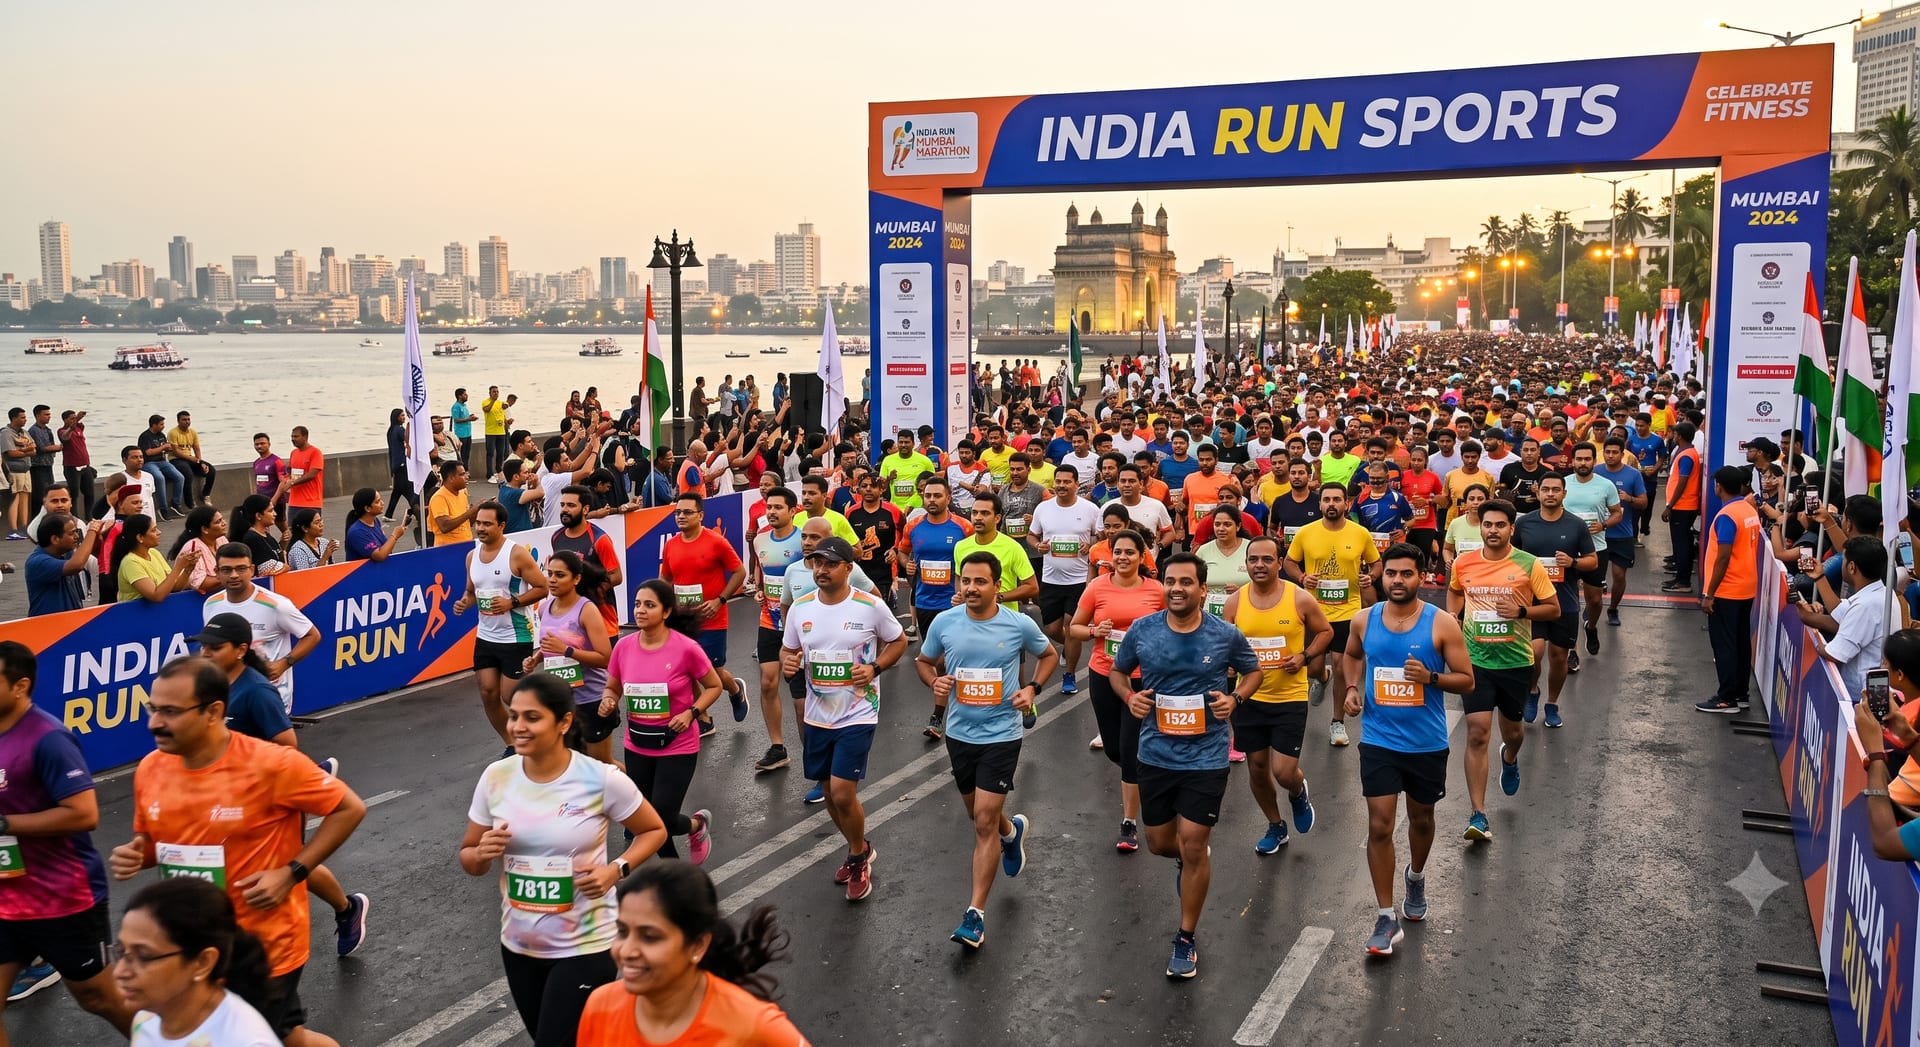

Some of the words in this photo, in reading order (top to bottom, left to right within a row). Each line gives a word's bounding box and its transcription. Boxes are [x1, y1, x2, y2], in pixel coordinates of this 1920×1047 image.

[1705, 80, 1813, 100] CELEBRATE
[1704, 98, 1810, 122] FITNESS
[1037, 110, 1196, 162] INDIA
[1213, 101, 1345, 155] RUN
[1359, 83, 1620, 149] SPORTS
[916, 128, 938, 137] INDIA
[939, 127, 955, 136] RUN
[916, 136, 955, 147] MUMBAI
[916, 146, 970, 157] MARATHON
[1731, 190, 1820, 208] MUMBAI
[1748, 210, 1799, 226] 2024
[875, 220, 936, 235] MUMBAI
[944, 221, 971, 236] MUMBAI
[888, 236, 923, 249] 2024
[949, 236, 966, 250] 2024
[925, 570, 946, 579] 9823
[335, 583, 428, 633] INDIA
[335, 623, 407, 671] RUN
[62, 632, 191, 694] INDIA
[816, 665, 845, 677] 7079
[962, 684, 995, 697] 4535
[1383, 683, 1415, 697] 1024
[1164, 711, 1197, 726] 1524
[1803, 692, 1824, 784] INDIA
[1798, 746, 1816, 829] RUN
[514, 878, 561, 900] 7812
[1847, 831, 1885, 989] INDIA
[1841, 907, 1872, 1047] RUN
